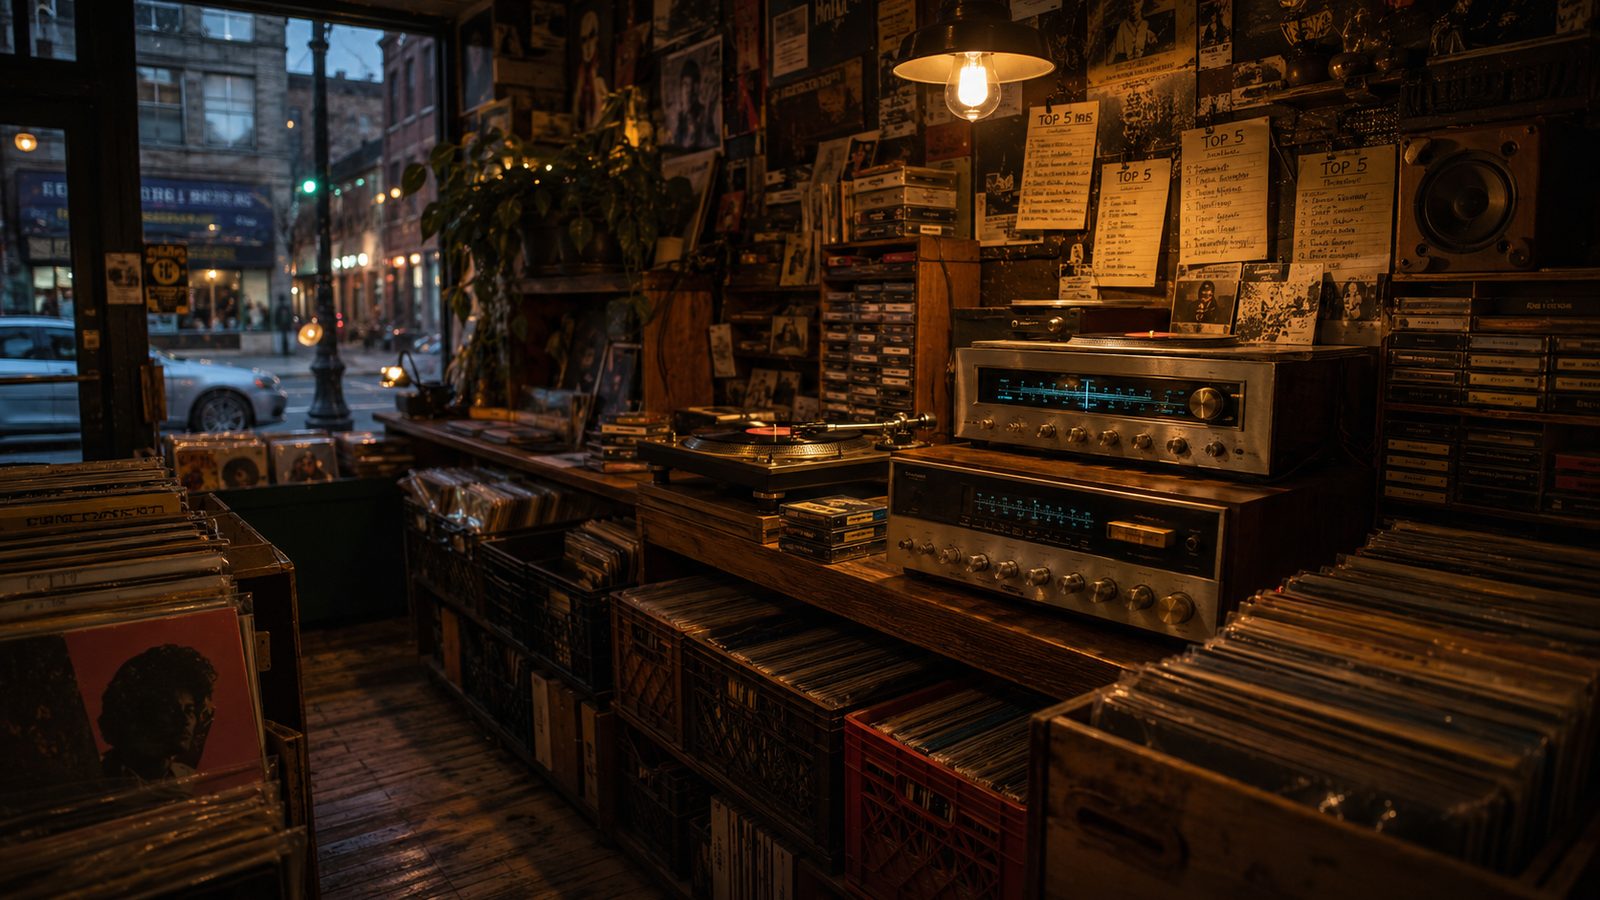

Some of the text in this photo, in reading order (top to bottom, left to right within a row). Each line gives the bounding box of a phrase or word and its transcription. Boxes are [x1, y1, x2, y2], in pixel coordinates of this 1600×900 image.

[1038, 113, 1060, 126] TOP
[1063, 111, 1072, 124] 5
[1201, 129, 1245, 148] TOP 5
[1320, 157, 1368, 176] TOP 5
[1116, 168, 1152, 183] TOP 5
